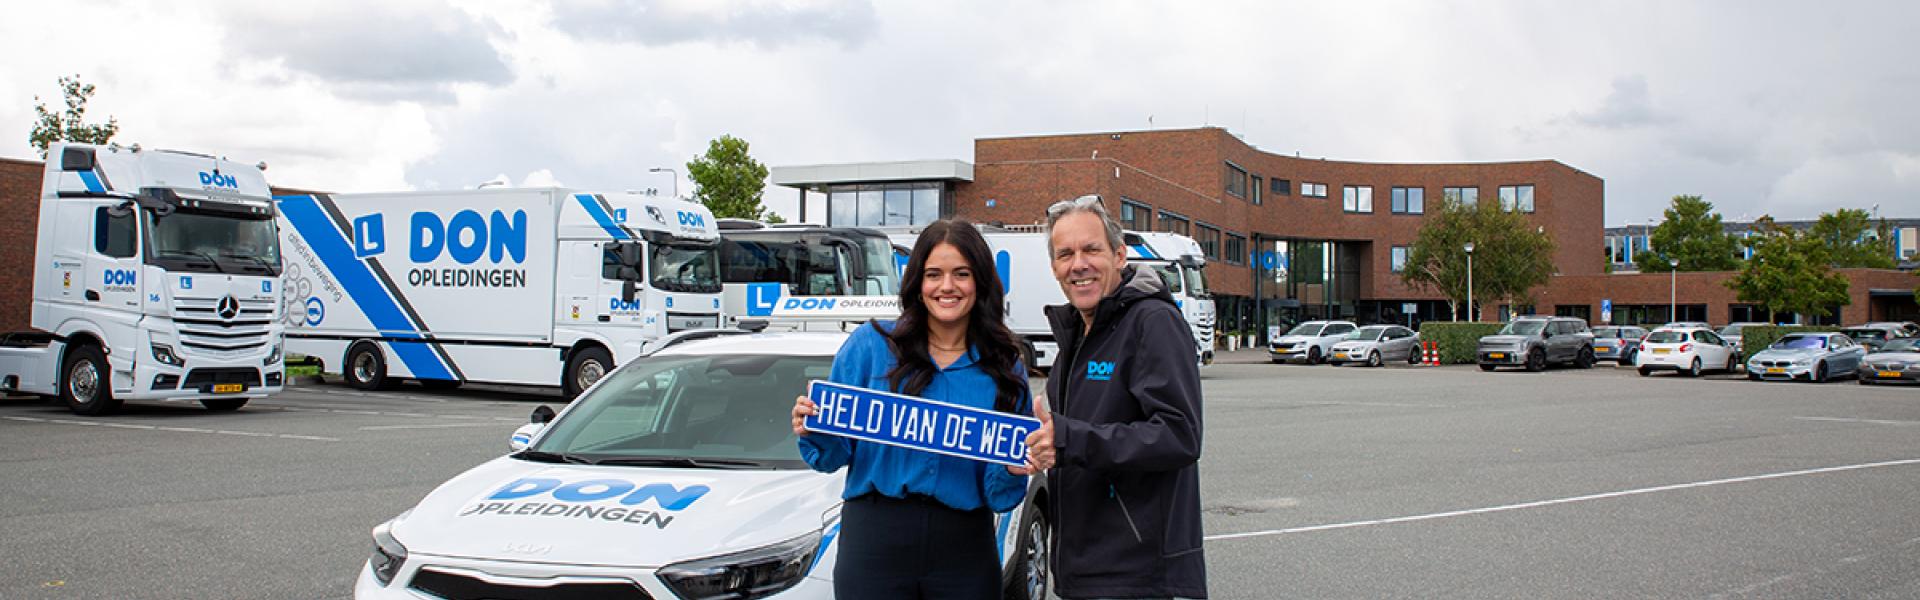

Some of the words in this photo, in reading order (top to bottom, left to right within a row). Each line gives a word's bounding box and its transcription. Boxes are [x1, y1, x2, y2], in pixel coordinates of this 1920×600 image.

[199, 171, 238, 189] DON
[677, 211, 705, 228] DON
[363, 221, 378, 250] L
[410, 209, 527, 264] DON
[104, 269, 136, 284] DON
[408, 268, 526, 287] OPLEIDINGEN
[611, 297, 640, 310] DON
[757, 287, 771, 308] L
[784, 298, 836, 310] DON
[1088, 361, 1115, 374] DON
[818, 390, 884, 434] HELD
[893, 403, 938, 444] VAN
[943, 413, 976, 451] DE
[980, 420, 1027, 460] WEG
[487, 478, 711, 511] DON
